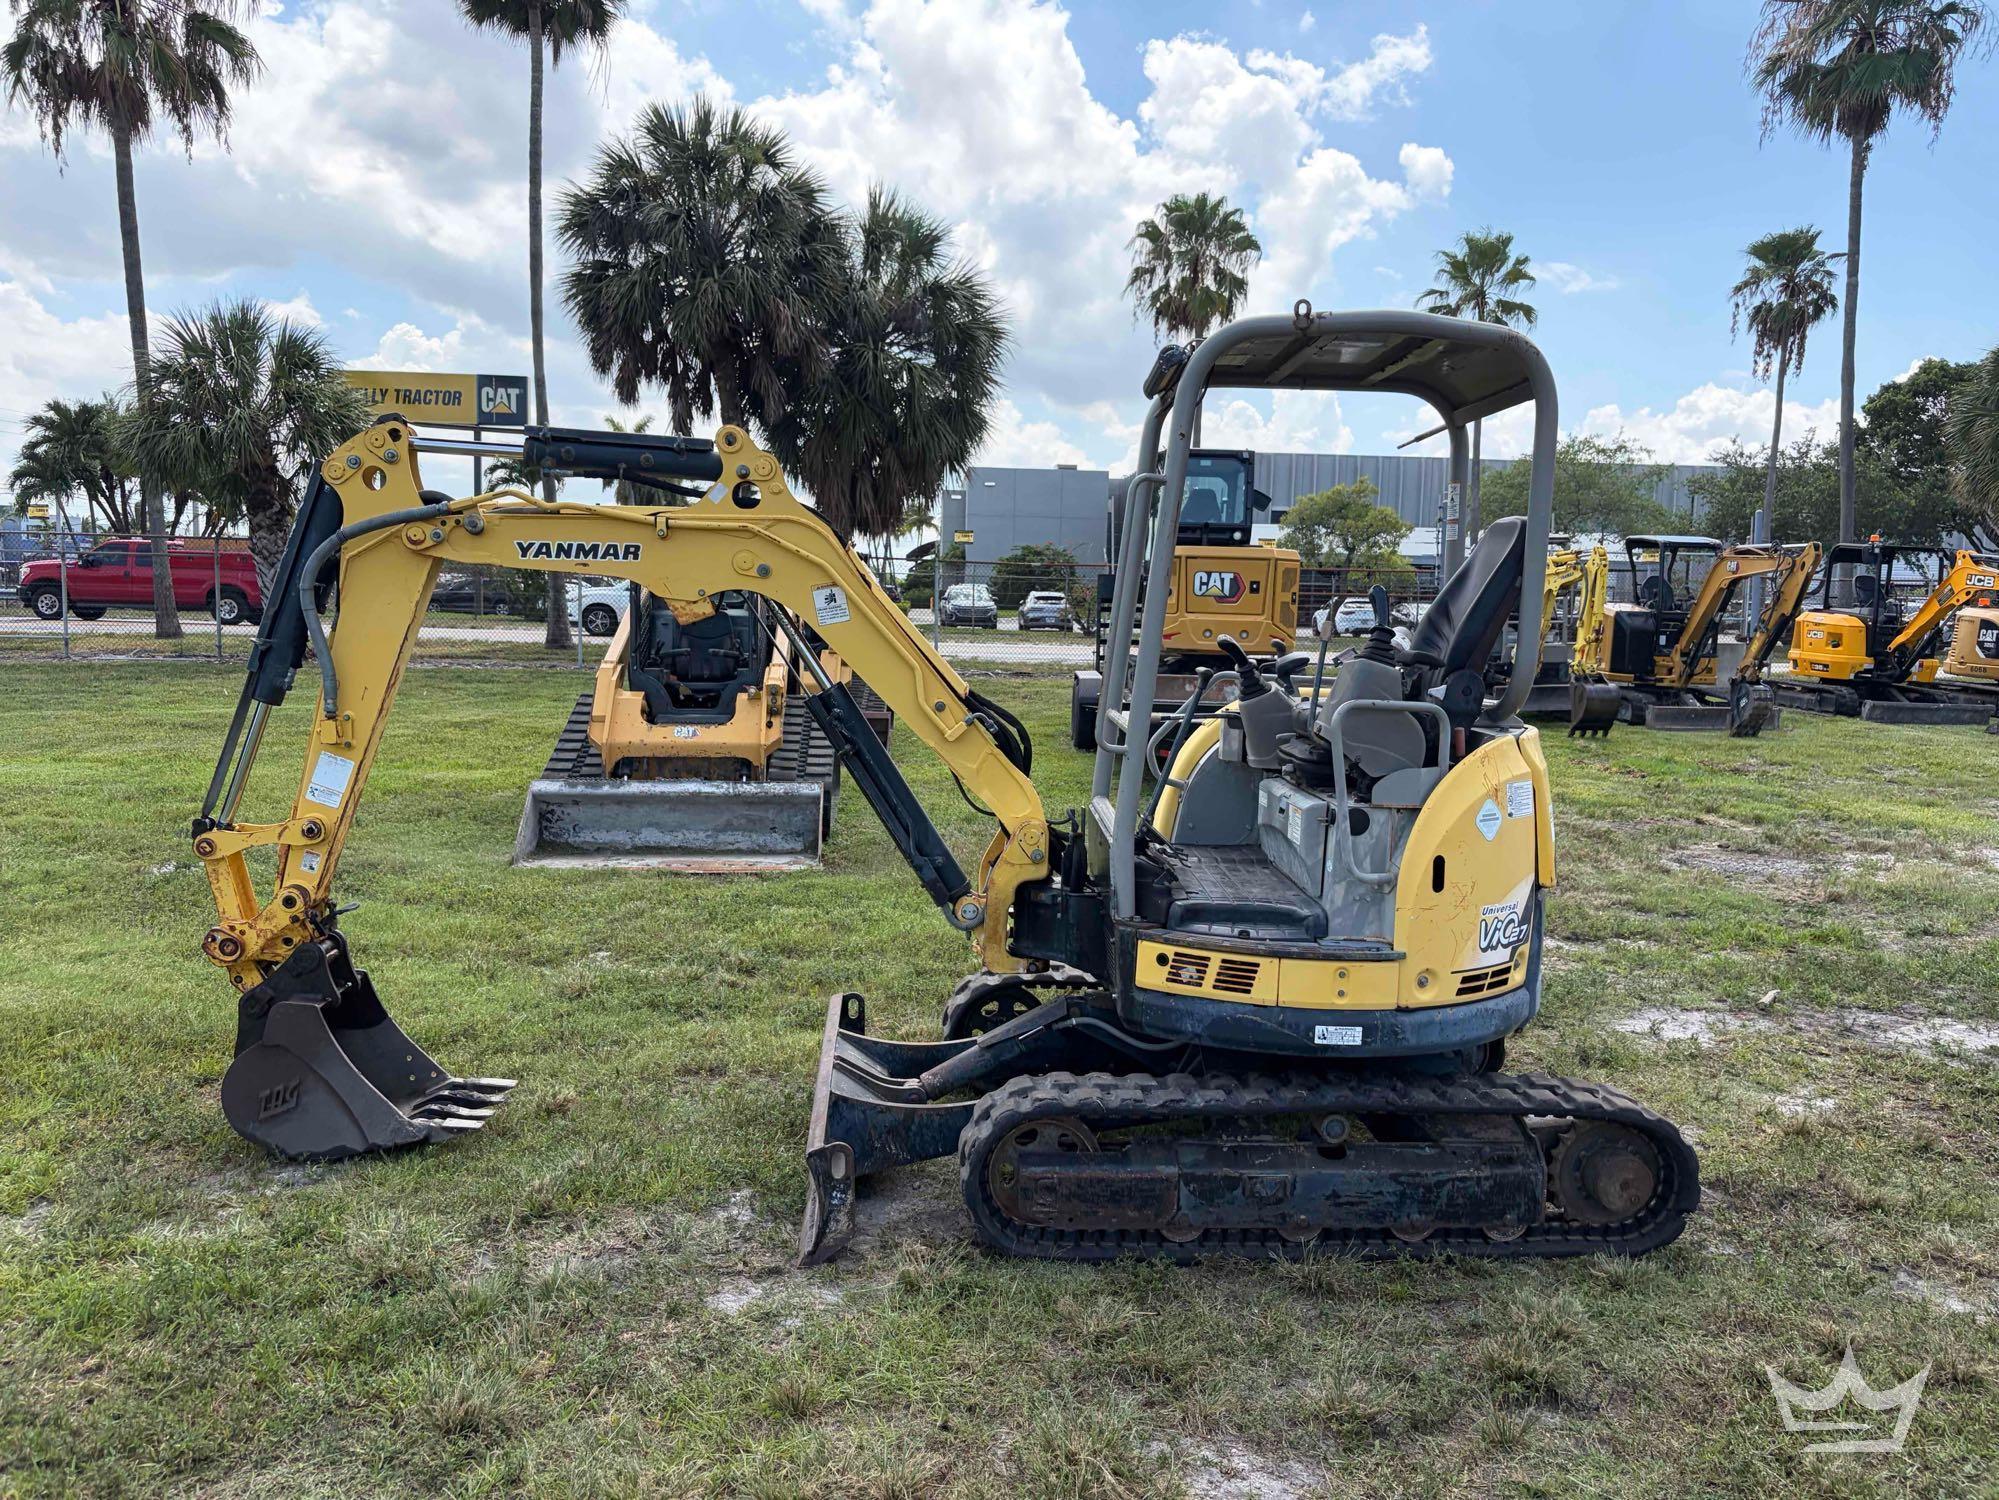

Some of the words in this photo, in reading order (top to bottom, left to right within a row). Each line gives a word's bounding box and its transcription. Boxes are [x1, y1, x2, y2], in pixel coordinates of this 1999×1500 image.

[394, 388, 463, 407] TRACTOR
[481, 386, 519, 414] CAT
[514, 540, 642, 561] YANMAR
[1193, 571, 1234, 597] CAT
[1966, 574, 1995, 588] JCB
[1806, 630, 1824, 639] JCB
[1979, 629, 1999, 641] CAT
[1482, 901, 1519, 916] Universal
